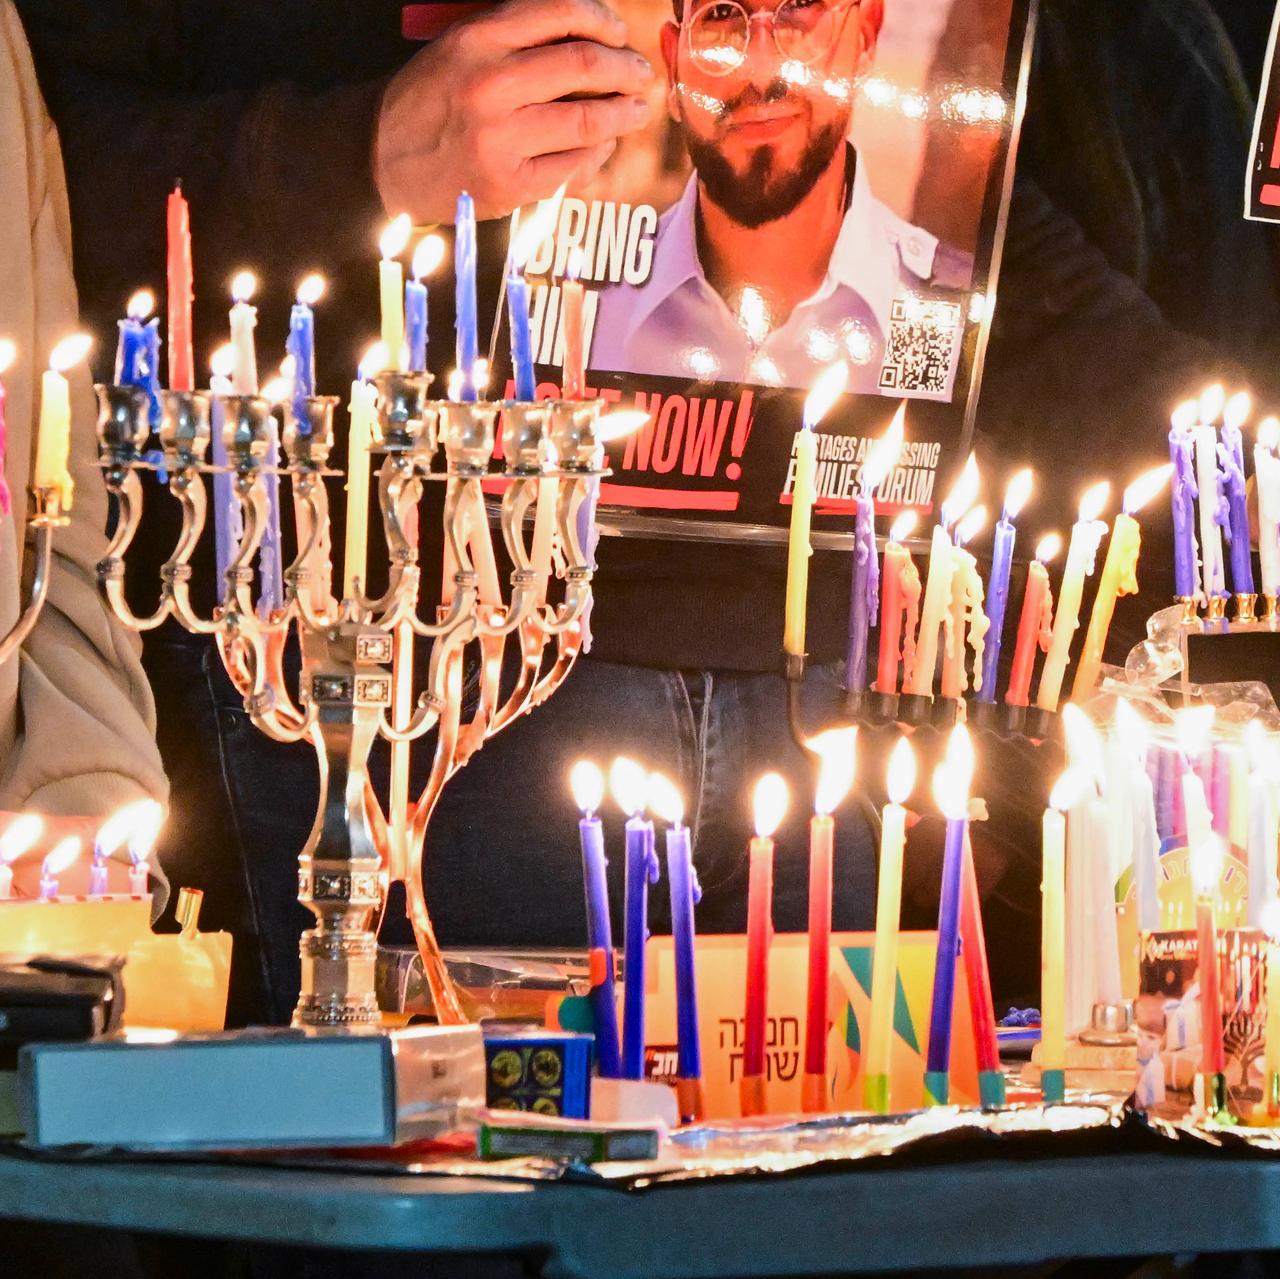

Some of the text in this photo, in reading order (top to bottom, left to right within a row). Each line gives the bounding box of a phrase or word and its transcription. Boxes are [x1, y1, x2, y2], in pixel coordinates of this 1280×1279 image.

[622, 389, 755, 481] NOW!
[790, 431, 857, 462] STAGES
[899, 441, 942, 469] SSING
[783, 458, 936, 506] FMILIES ORUM
[719, 1016, 799, 1049] חנה
[729, 1051, 799, 1084] שח
